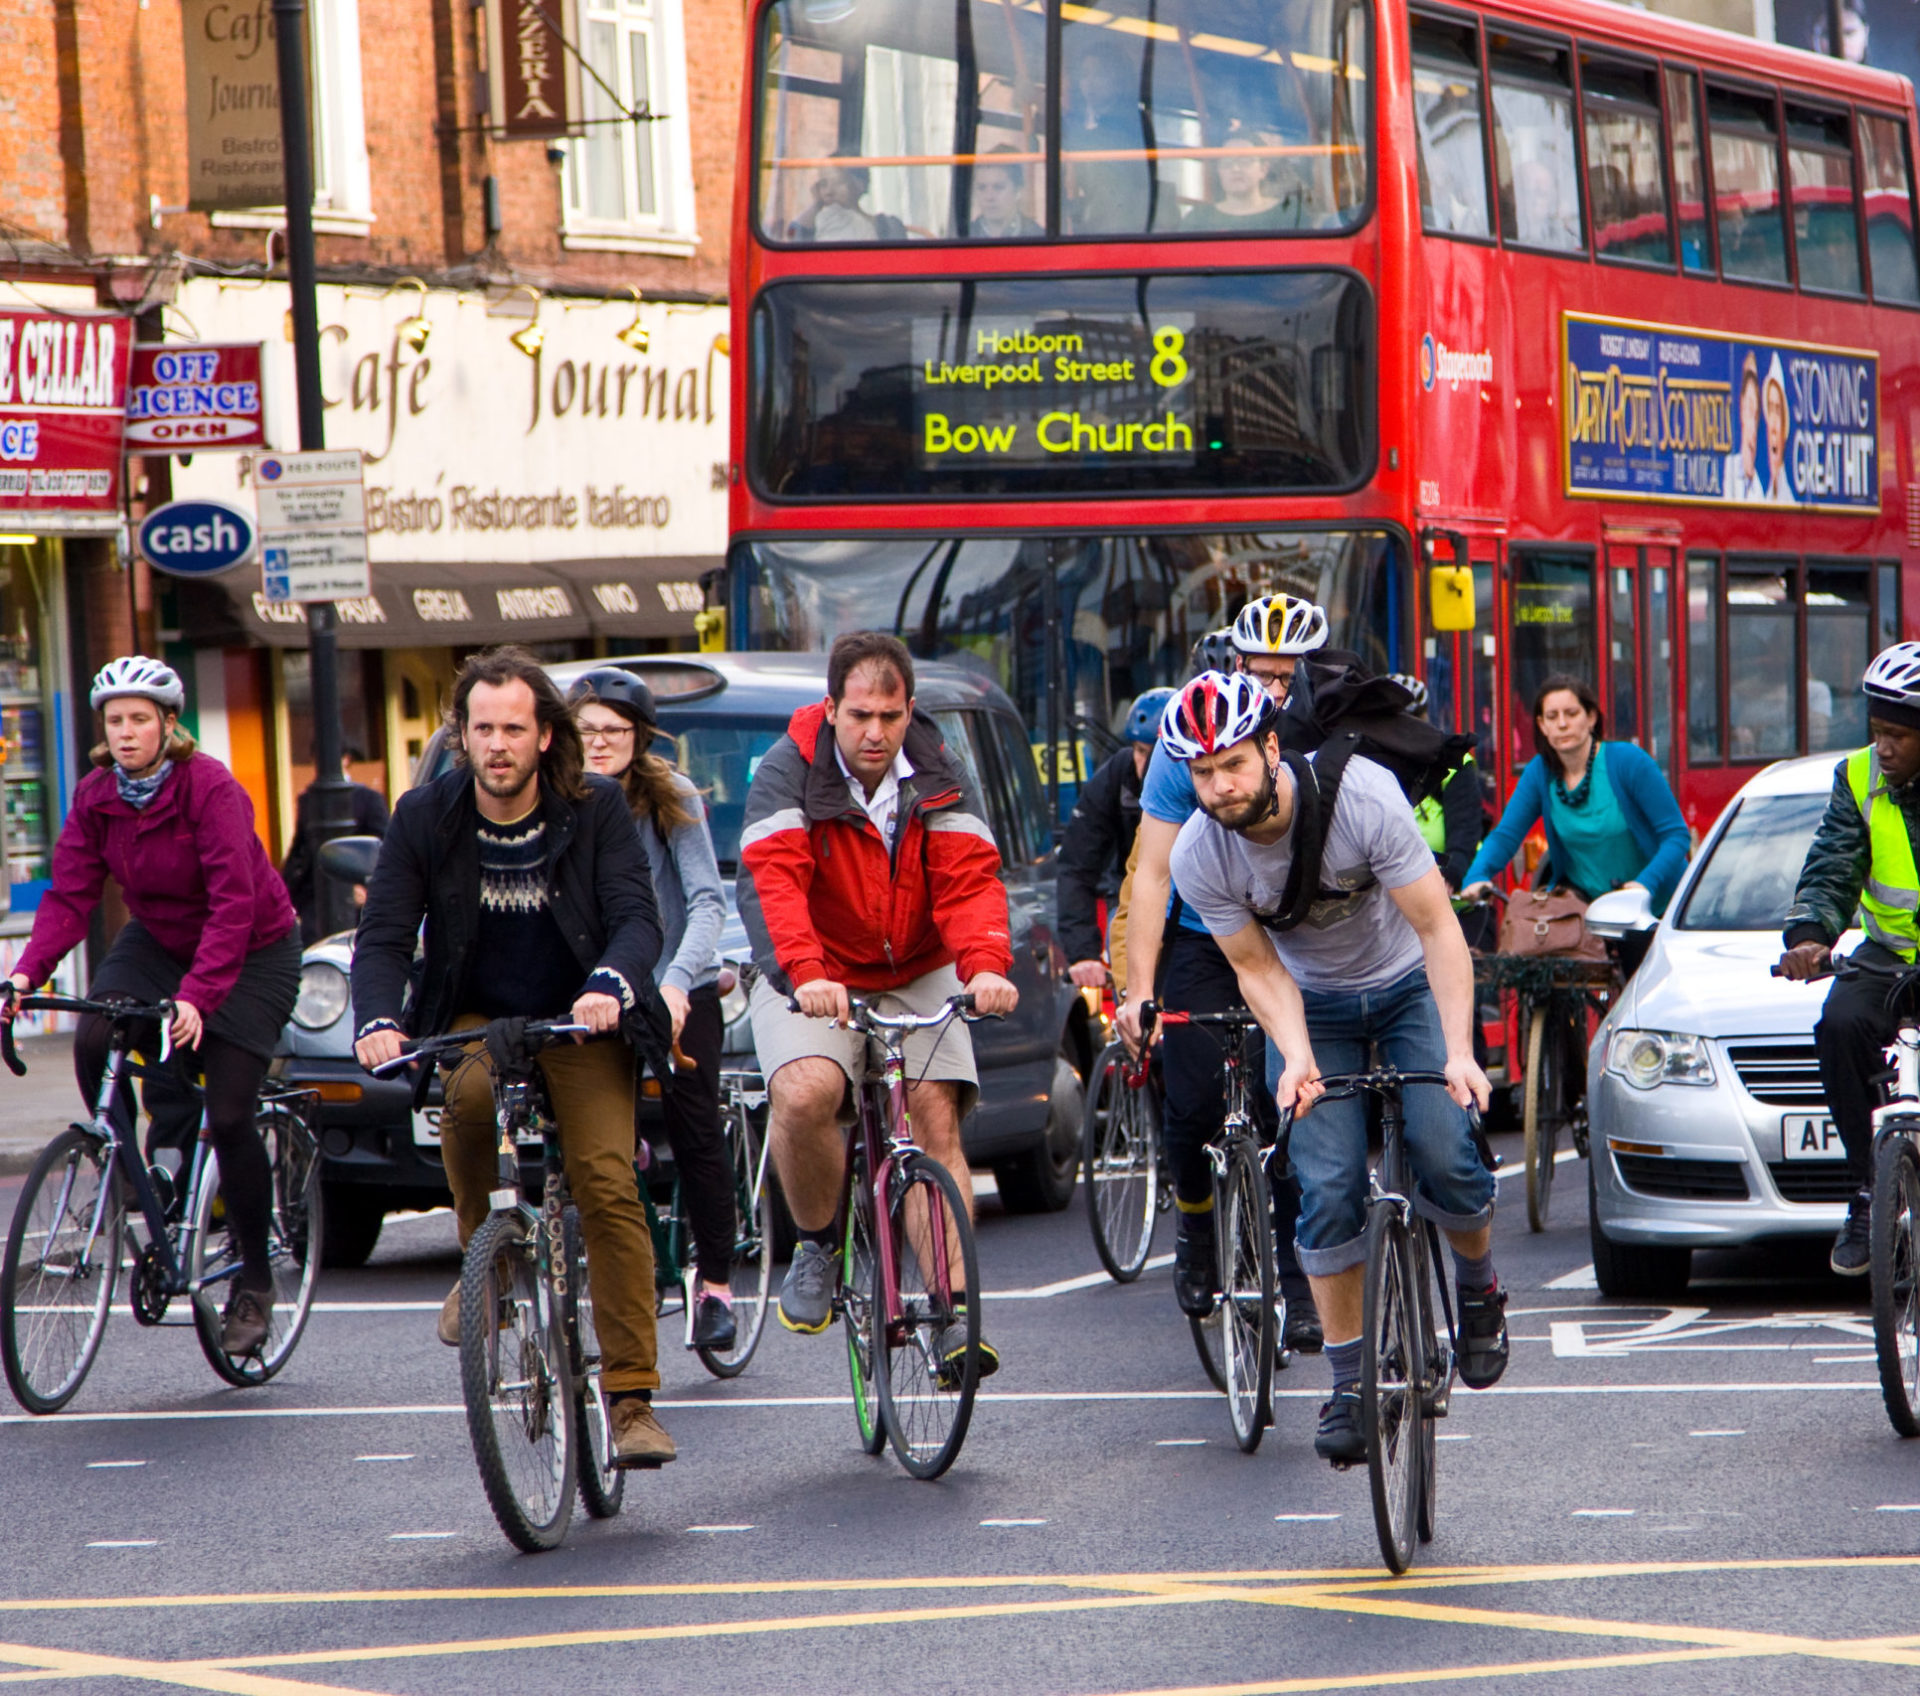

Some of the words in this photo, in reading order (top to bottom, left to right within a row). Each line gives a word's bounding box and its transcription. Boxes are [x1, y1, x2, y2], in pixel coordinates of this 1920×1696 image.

[976, 329, 1083, 354] Holborn
[1149, 325, 1188, 388] 8
[19, 320, 115, 406] CELLAR
[154, 352, 218, 383] OFF
[925, 357, 1043, 390] Liverpool
[1054, 356, 1135, 383] Street
[525, 333, 717, 436] Journal
[152, 422, 227, 439] OPEN
[924, 413, 1017, 453] Bow
[1036, 411, 1193, 452] Church
[1792, 428, 1841, 496] GREAT
[450, 485, 577, 530] Ristorante
[587, 485, 669, 528] Italiano
[149, 513, 238, 554] cash
